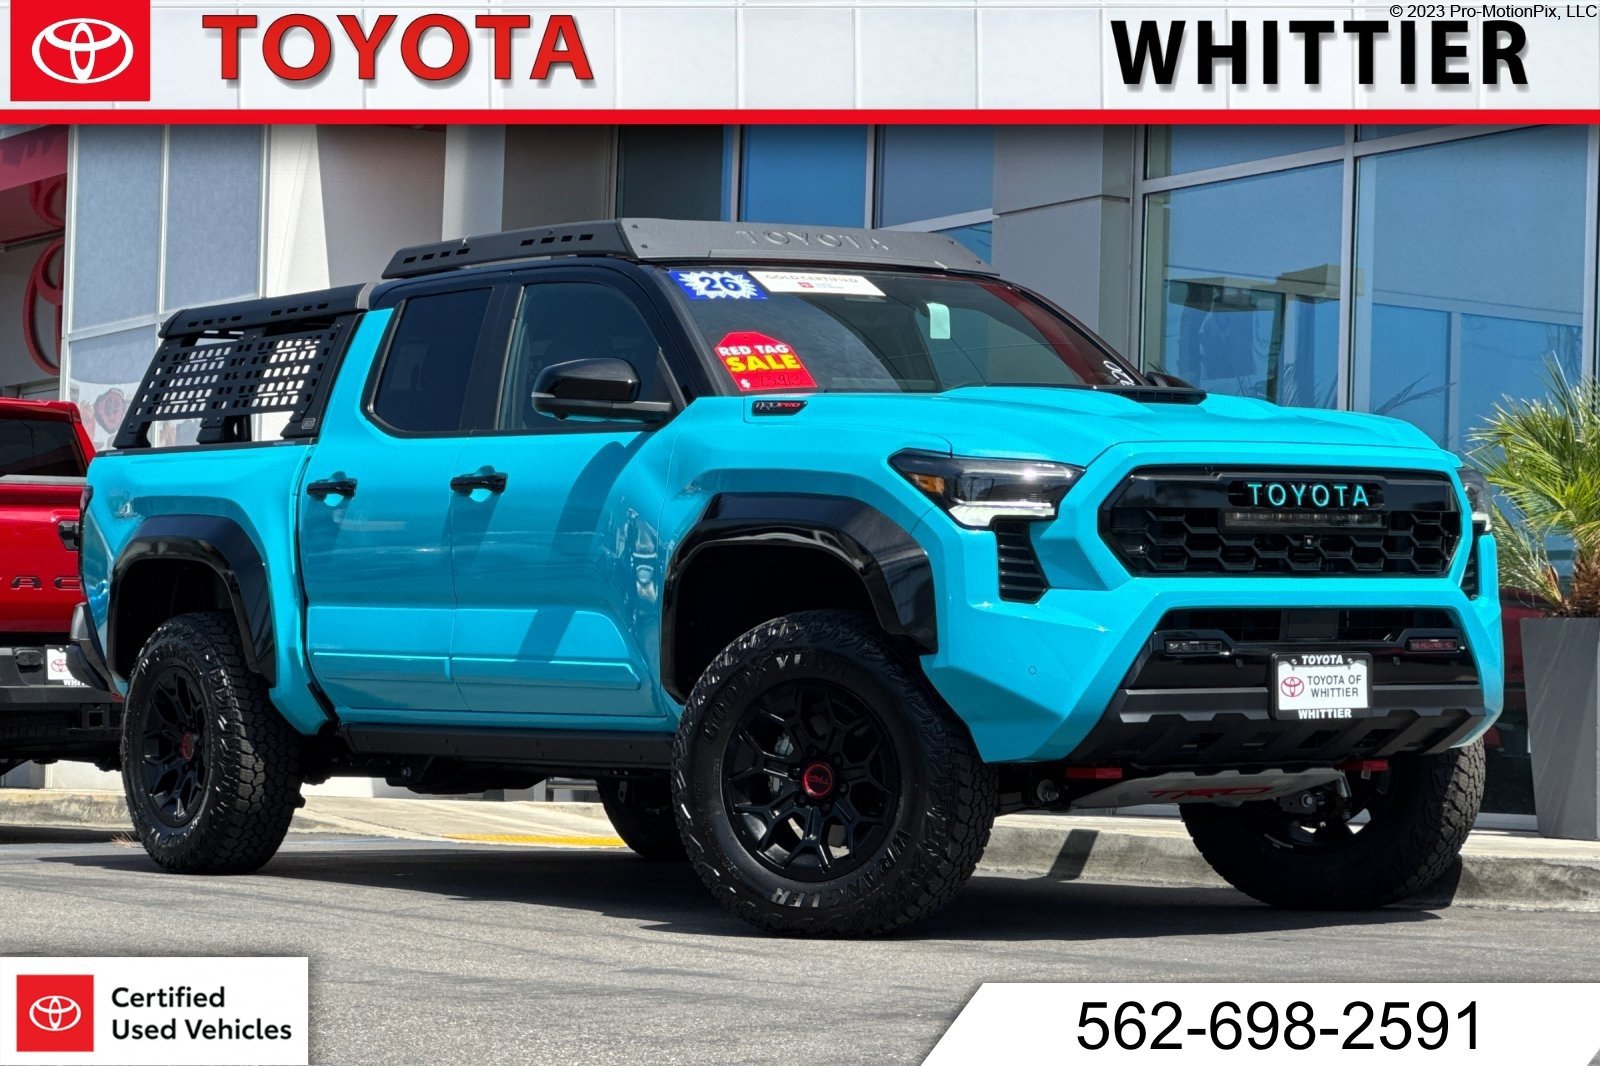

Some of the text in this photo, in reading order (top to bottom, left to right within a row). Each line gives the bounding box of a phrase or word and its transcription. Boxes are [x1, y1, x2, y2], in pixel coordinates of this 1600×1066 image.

[736, 229, 891, 251] TOYOTA
[699, 276, 742, 292] 26
[717, 344, 790, 356] RED TAG
[726, 354, 801, 373] SALE
[1247, 483, 1369, 507] TOYOTA
[1301, 654, 1344, 666] TOYOTA
[1307, 674, 1362, 686] TOYOTA OF
[1311, 686, 1359, 698] WHITTIER
[1298, 708, 1353, 720] WHITTIER
